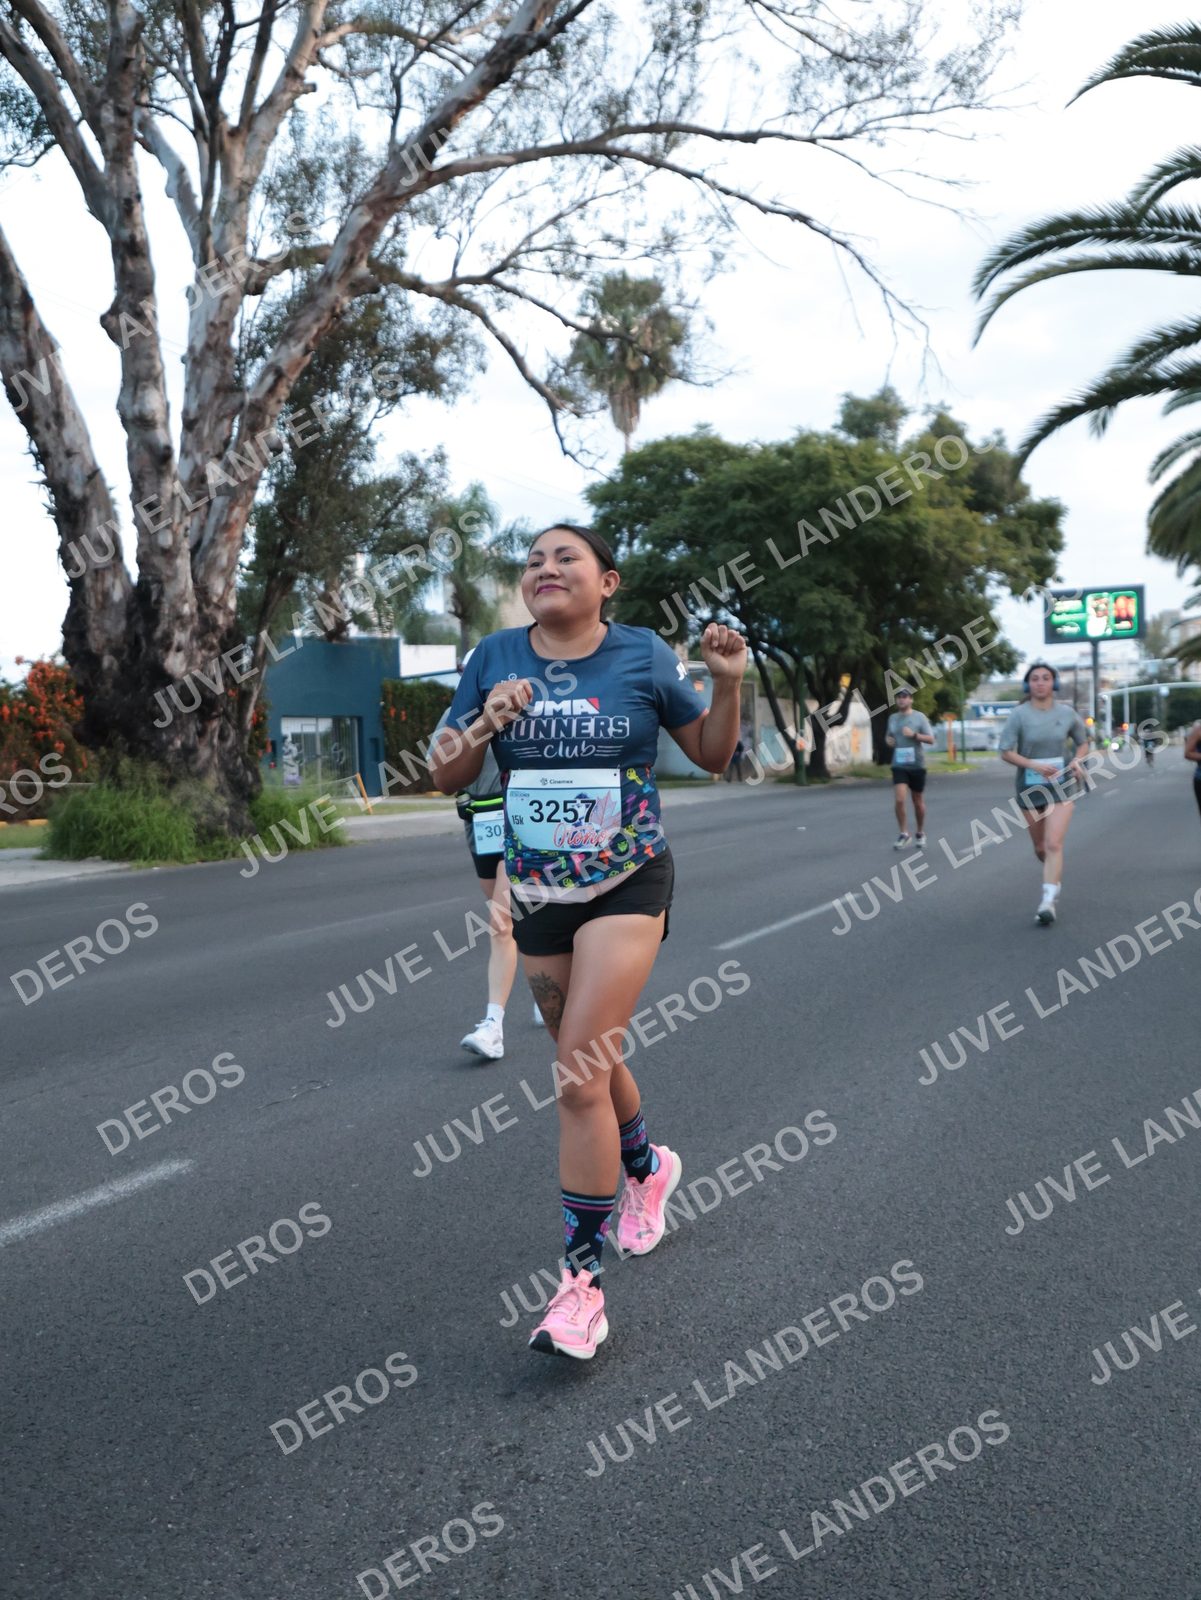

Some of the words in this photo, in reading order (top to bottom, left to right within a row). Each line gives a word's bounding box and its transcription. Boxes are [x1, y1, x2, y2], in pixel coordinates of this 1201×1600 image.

[500, 715, 629, 742] RUNNERS
[544, 740, 597, 758] club
[512, 814, 524, 825] 15k
[528, 800, 596, 824] 3257
[484, 824, 504, 838] 30
